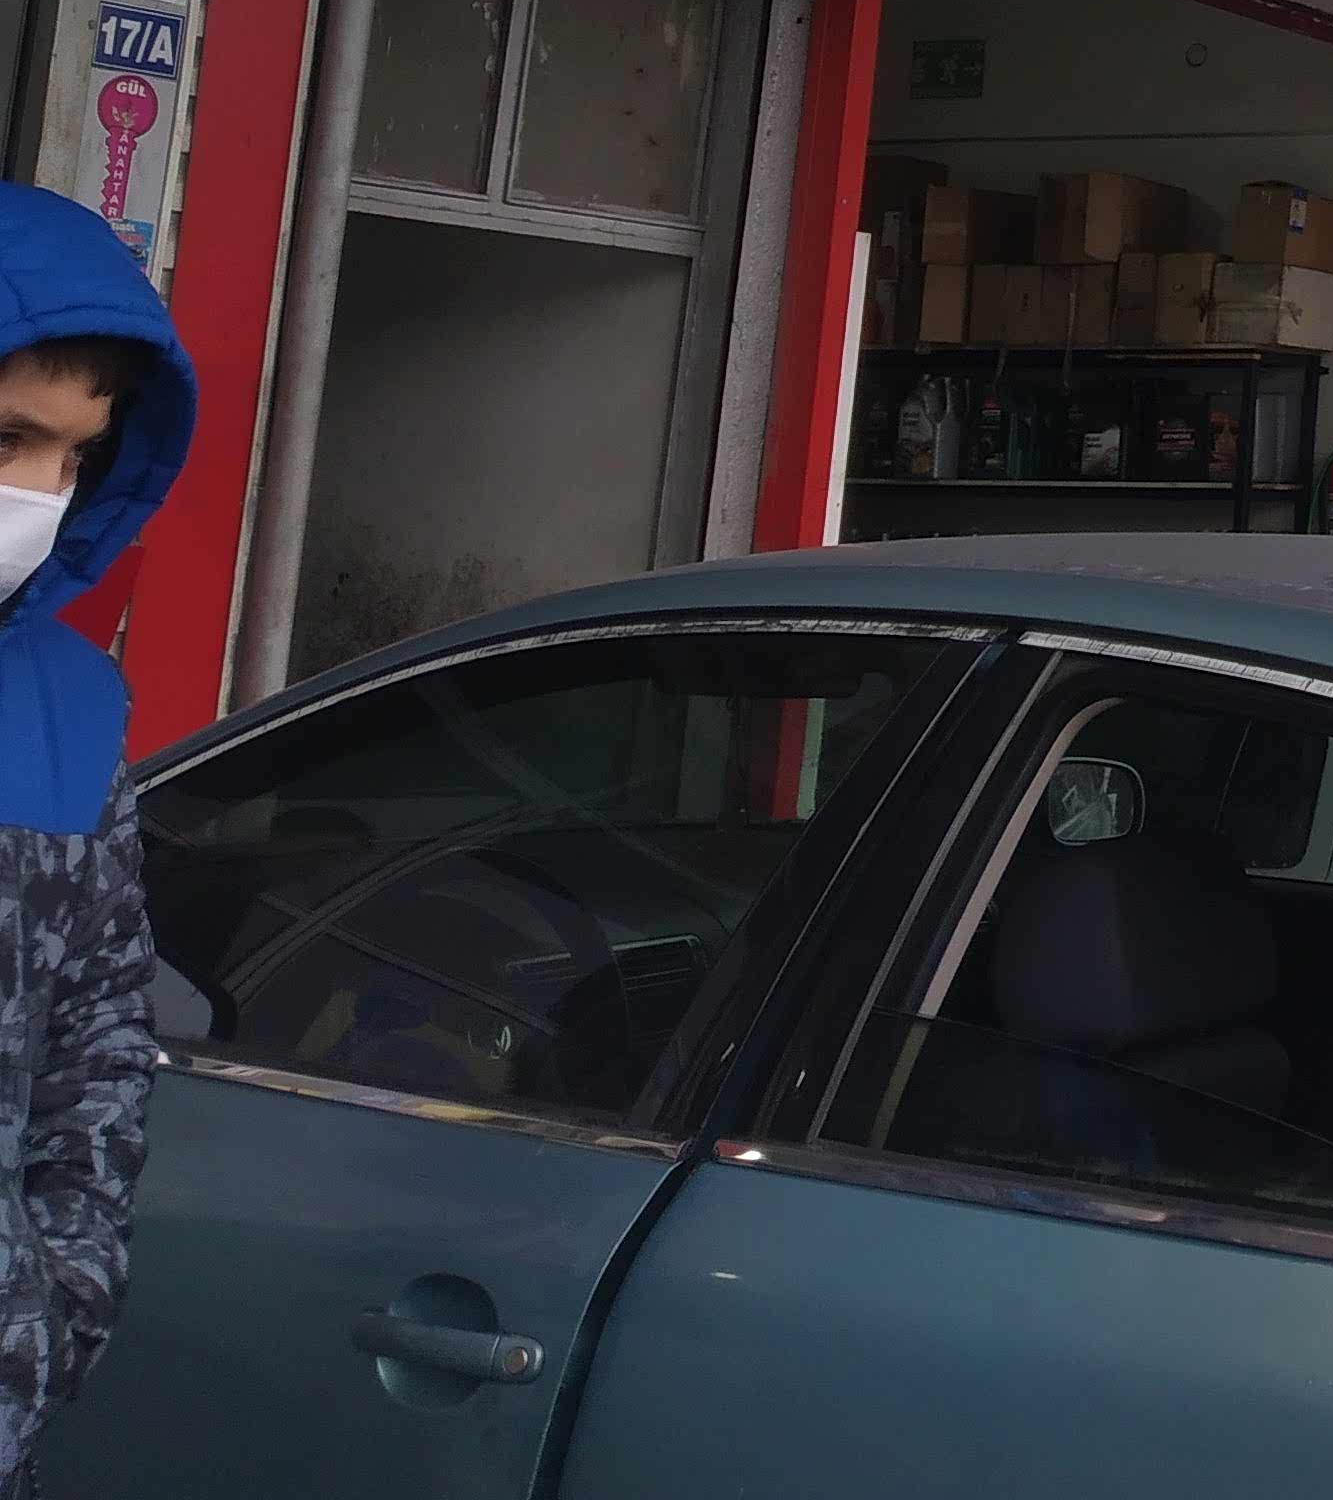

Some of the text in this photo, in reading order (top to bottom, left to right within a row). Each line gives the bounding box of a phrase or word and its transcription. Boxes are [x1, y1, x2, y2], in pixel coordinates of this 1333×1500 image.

[101, 15, 175, 67] 17/A
[116, 80, 147, 98] GÜL
[107, 134, 129, 216] ANAHTAR
